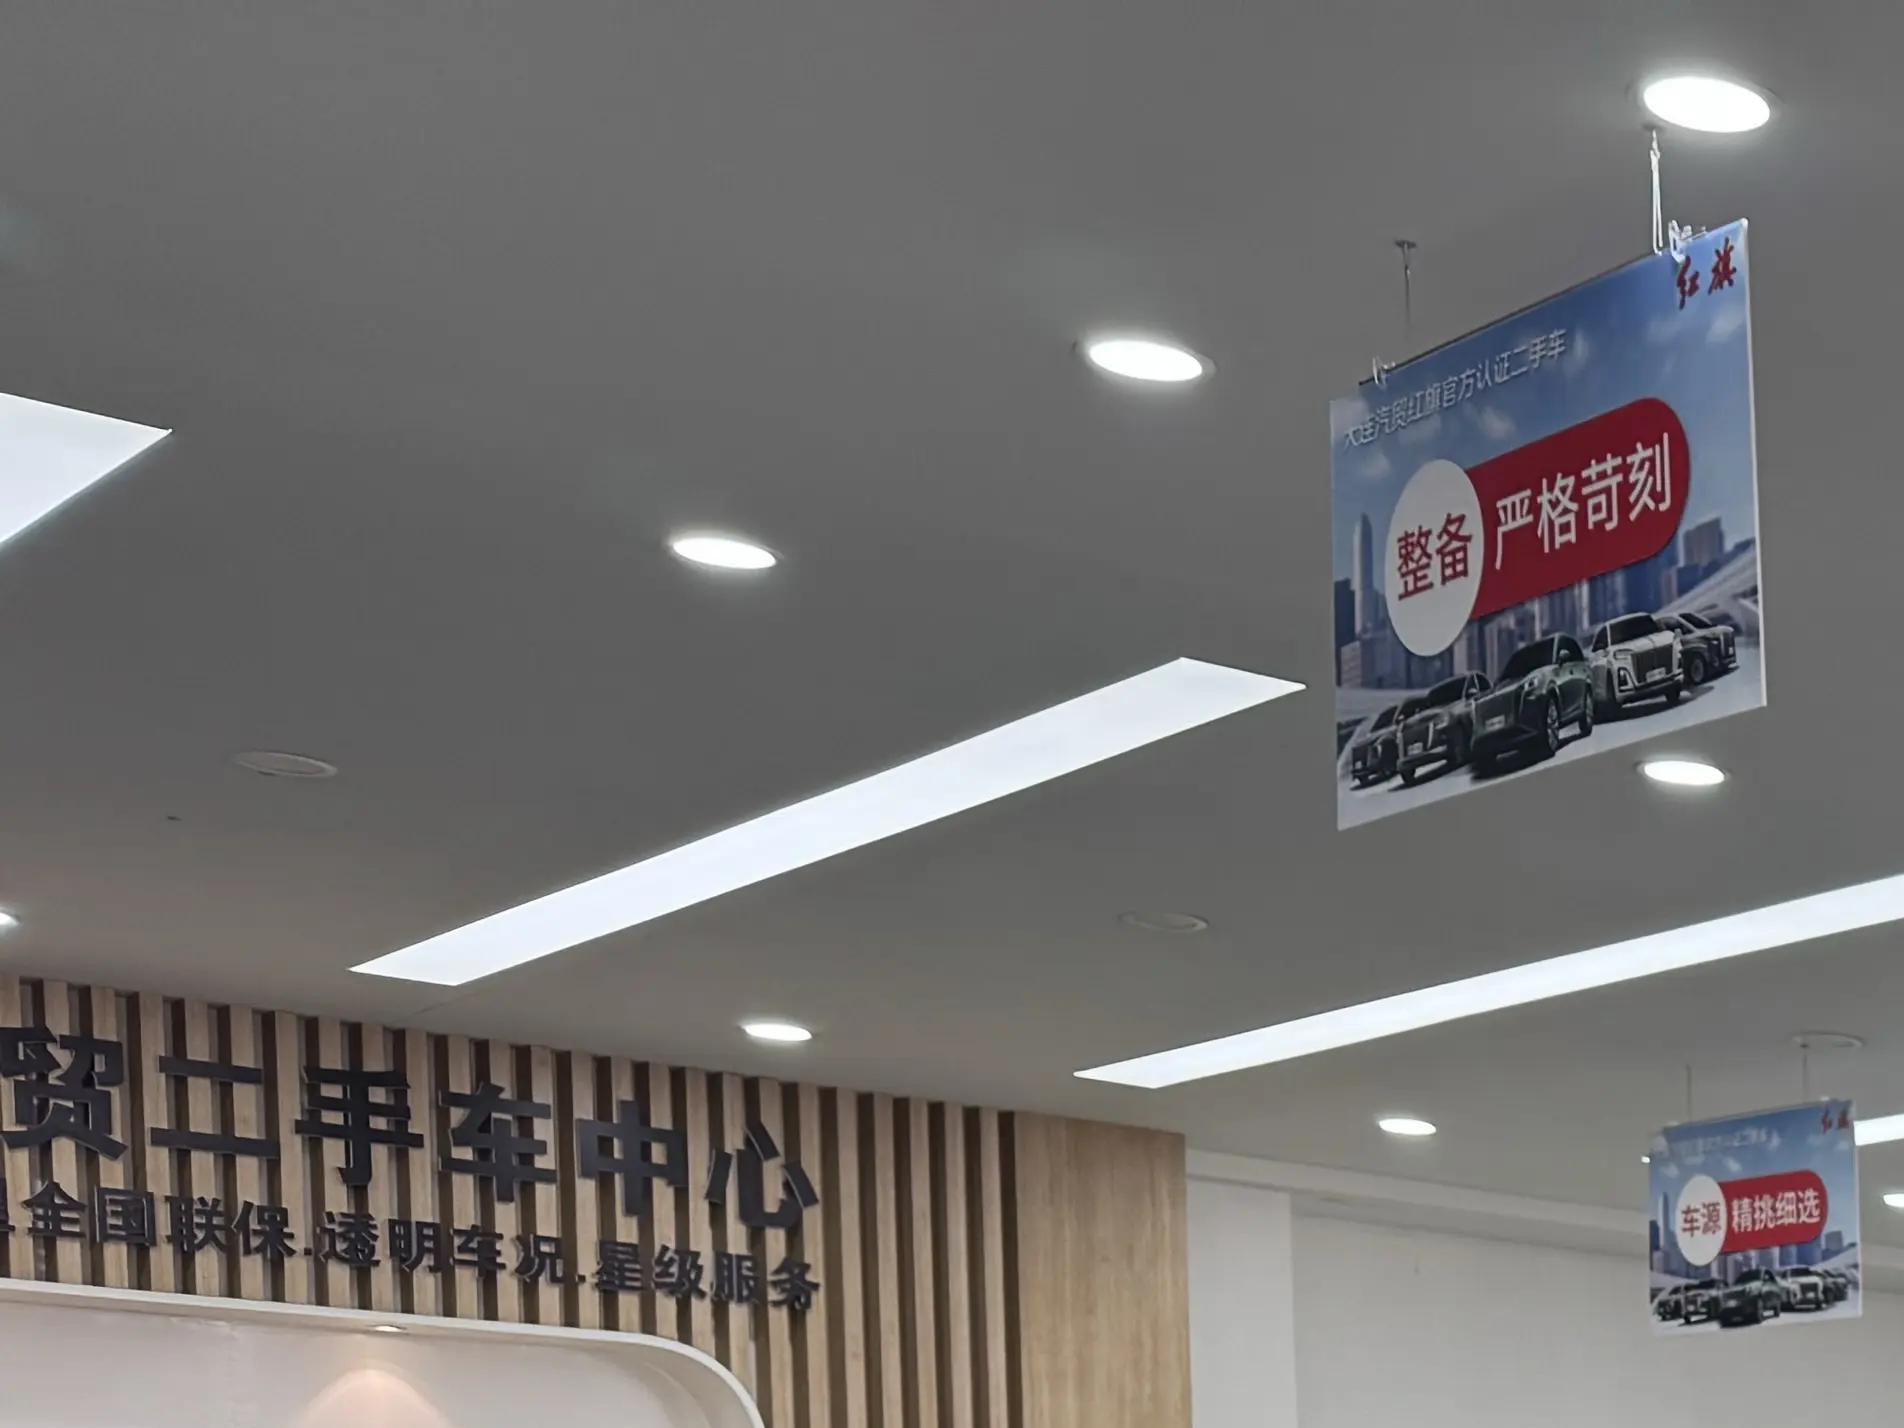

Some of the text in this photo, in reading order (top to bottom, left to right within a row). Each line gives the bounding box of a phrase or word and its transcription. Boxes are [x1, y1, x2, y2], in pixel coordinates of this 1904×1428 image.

[1396, 432, 1673, 602] 整备 严格苛刻
[0, 1026, 819, 1229] 贸二手车中心
[1681, 1188, 1821, 1237] 车源 精挑细选
